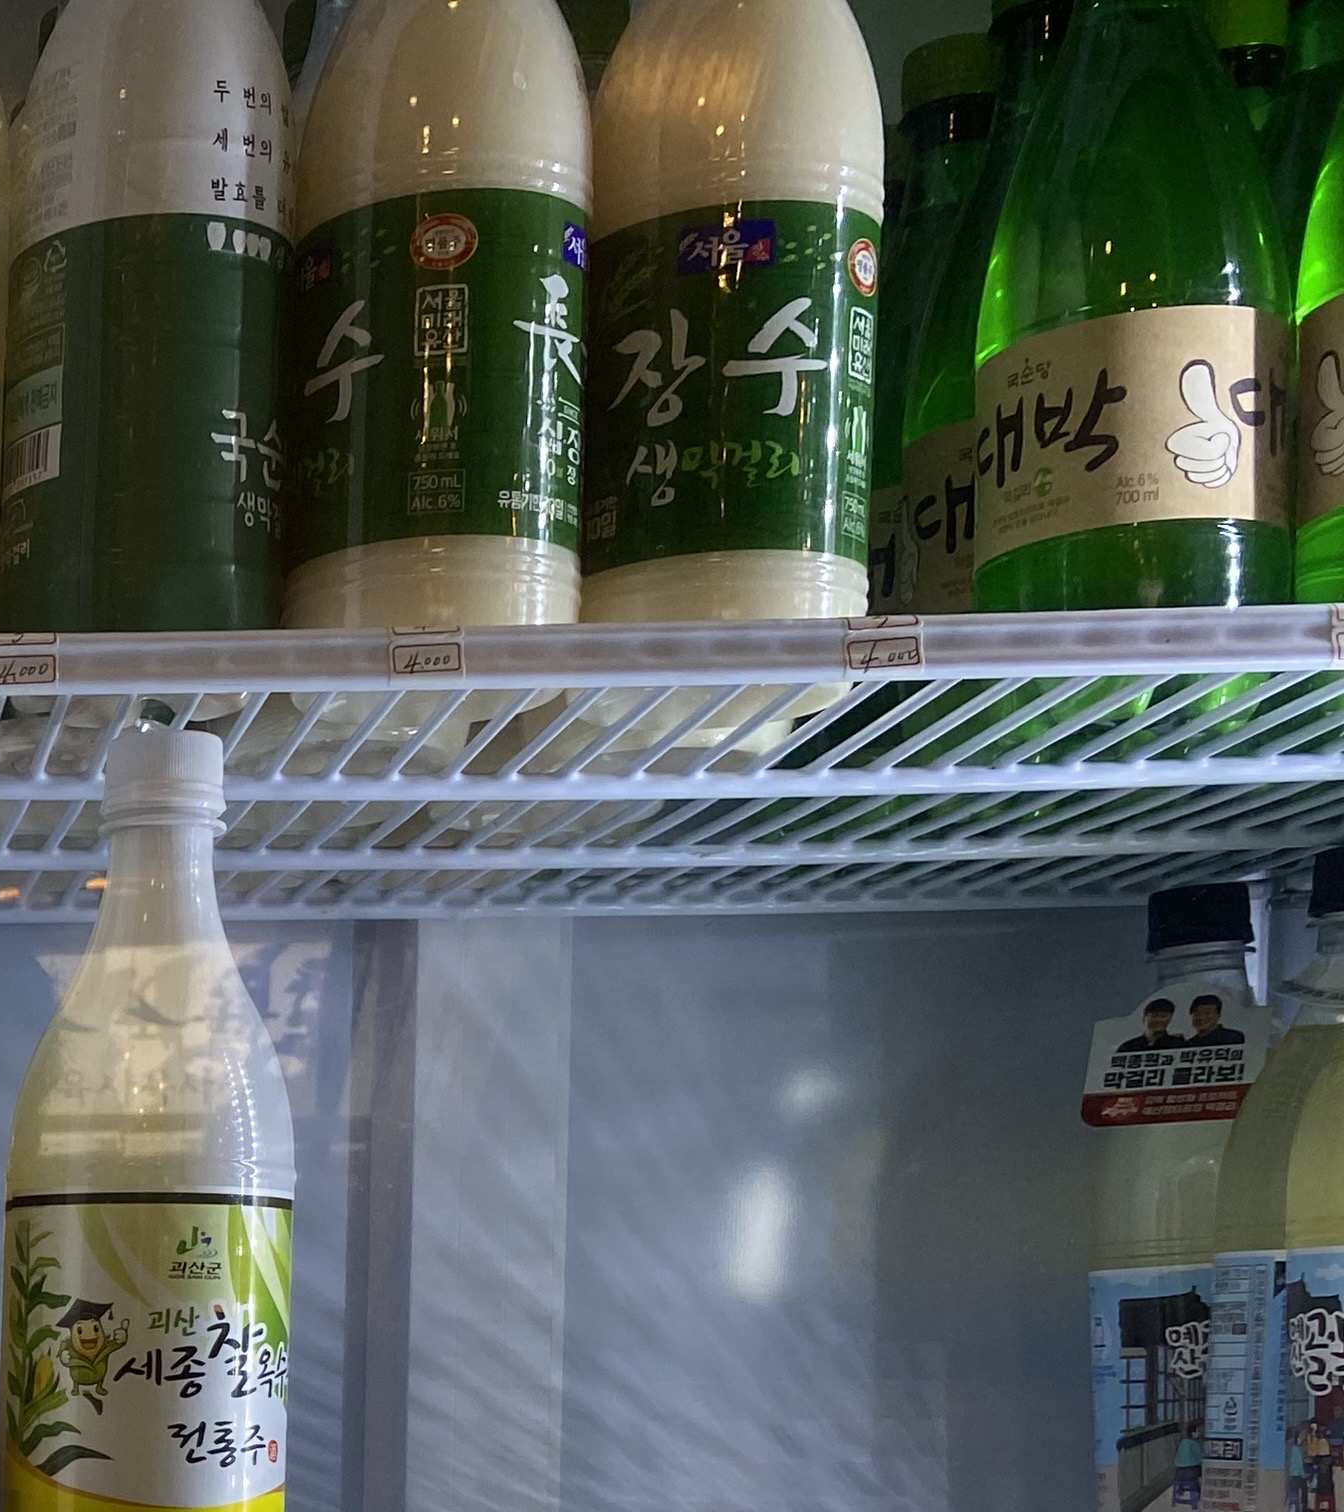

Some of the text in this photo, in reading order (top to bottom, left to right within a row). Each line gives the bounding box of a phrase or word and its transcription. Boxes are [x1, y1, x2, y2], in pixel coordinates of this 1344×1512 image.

[213, 79, 273, 116] 두 번의
[212, 128, 273, 164] 세 번의
[210, 177, 266, 211] 발효를
[607, 296, 830, 428] 장수
[1006, 357, 1051, 389] 국순당
[975, 366, 1128, 489] 대박
[625, 437, 802, 508] 생막걸리
[1103, 1068, 1166, 1090] 막걸리
[168, 1261, 223, 1275] 괴산군
[148, 1305, 200, 1337] 괴산
